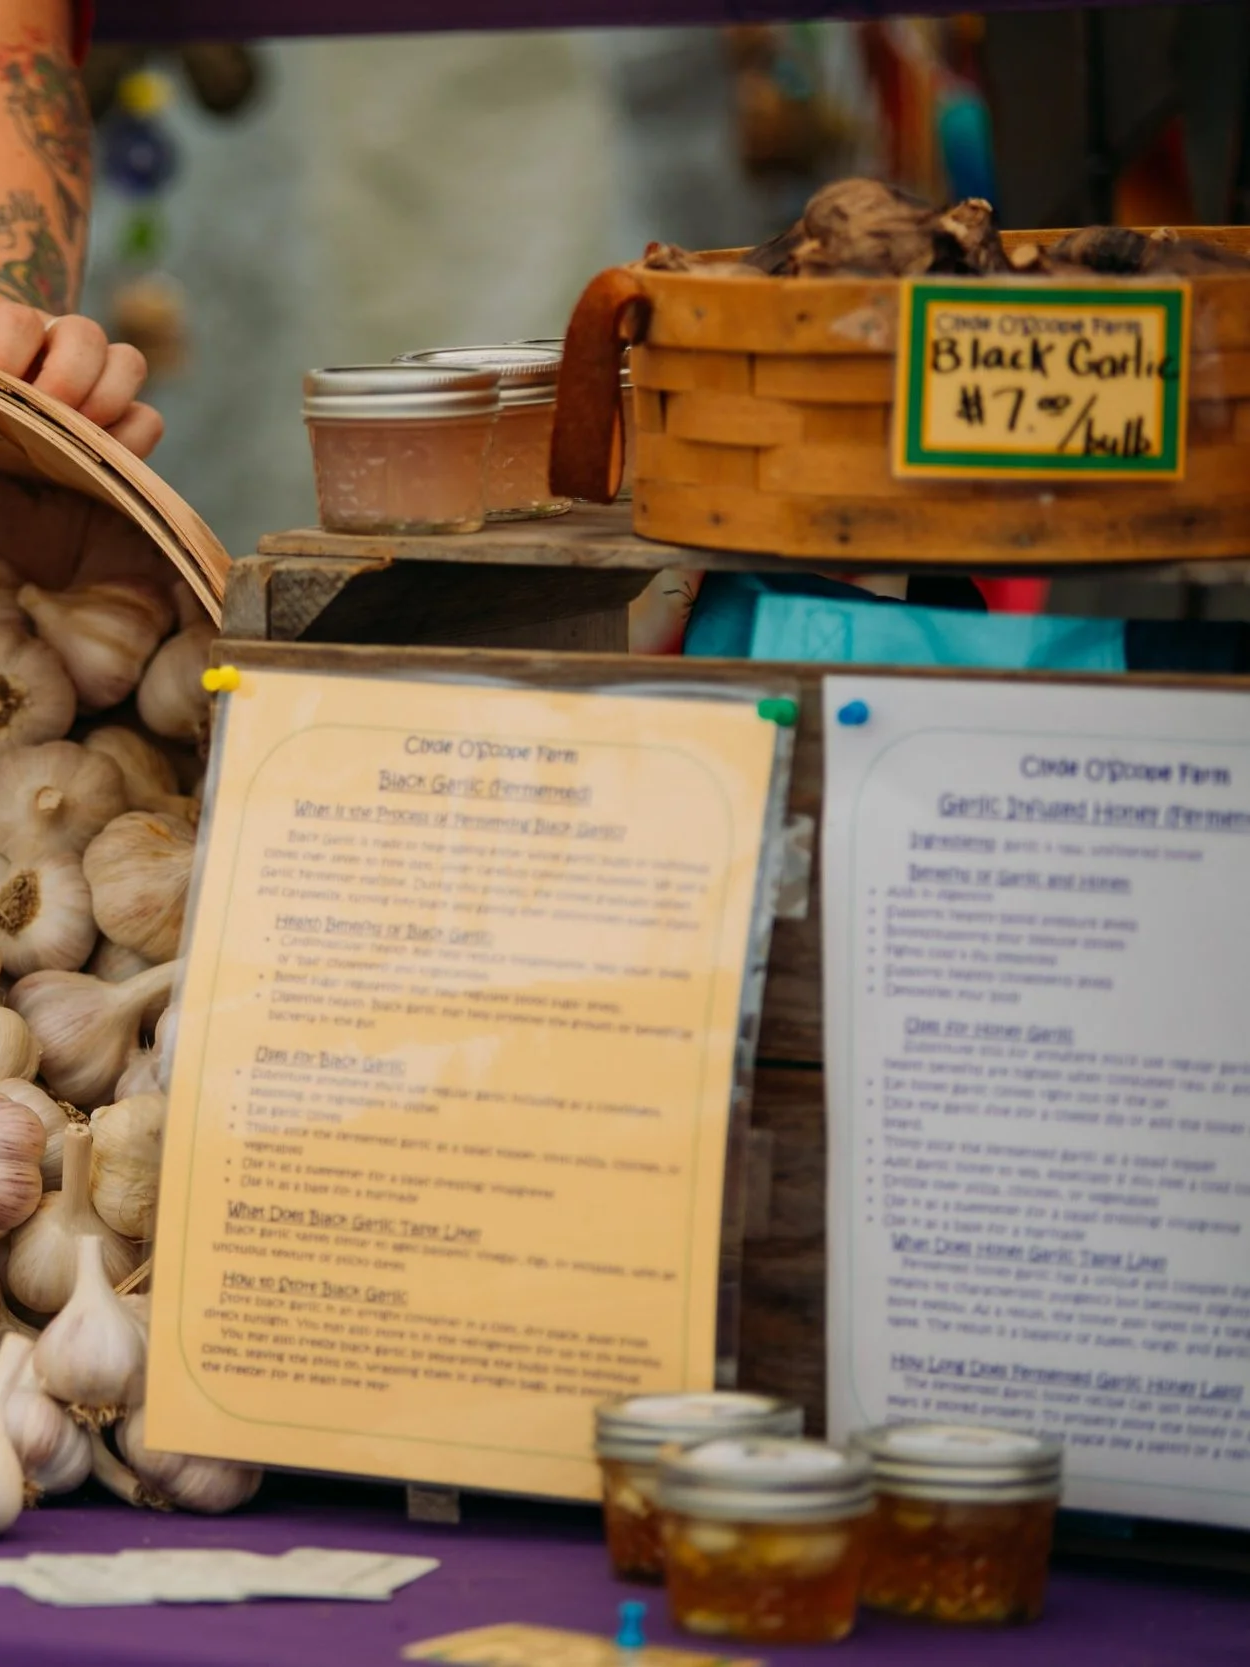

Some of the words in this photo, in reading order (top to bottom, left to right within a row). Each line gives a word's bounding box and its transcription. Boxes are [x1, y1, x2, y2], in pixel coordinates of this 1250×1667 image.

[931, 337, 1056, 378] Black
[1067, 336, 1180, 380] Garlic
[379, 770, 426, 792] Black
[432, 775, 483, 796] Garlic
[227, 1200, 263, 1220] What
[310, 1208, 347, 1228] Black
[352, 1213, 394, 1234] Garlic
[223, 1271, 254, 1288] How
[322, 1279, 359, 1298] Black
[364, 1285, 407, 1306] Garlic
